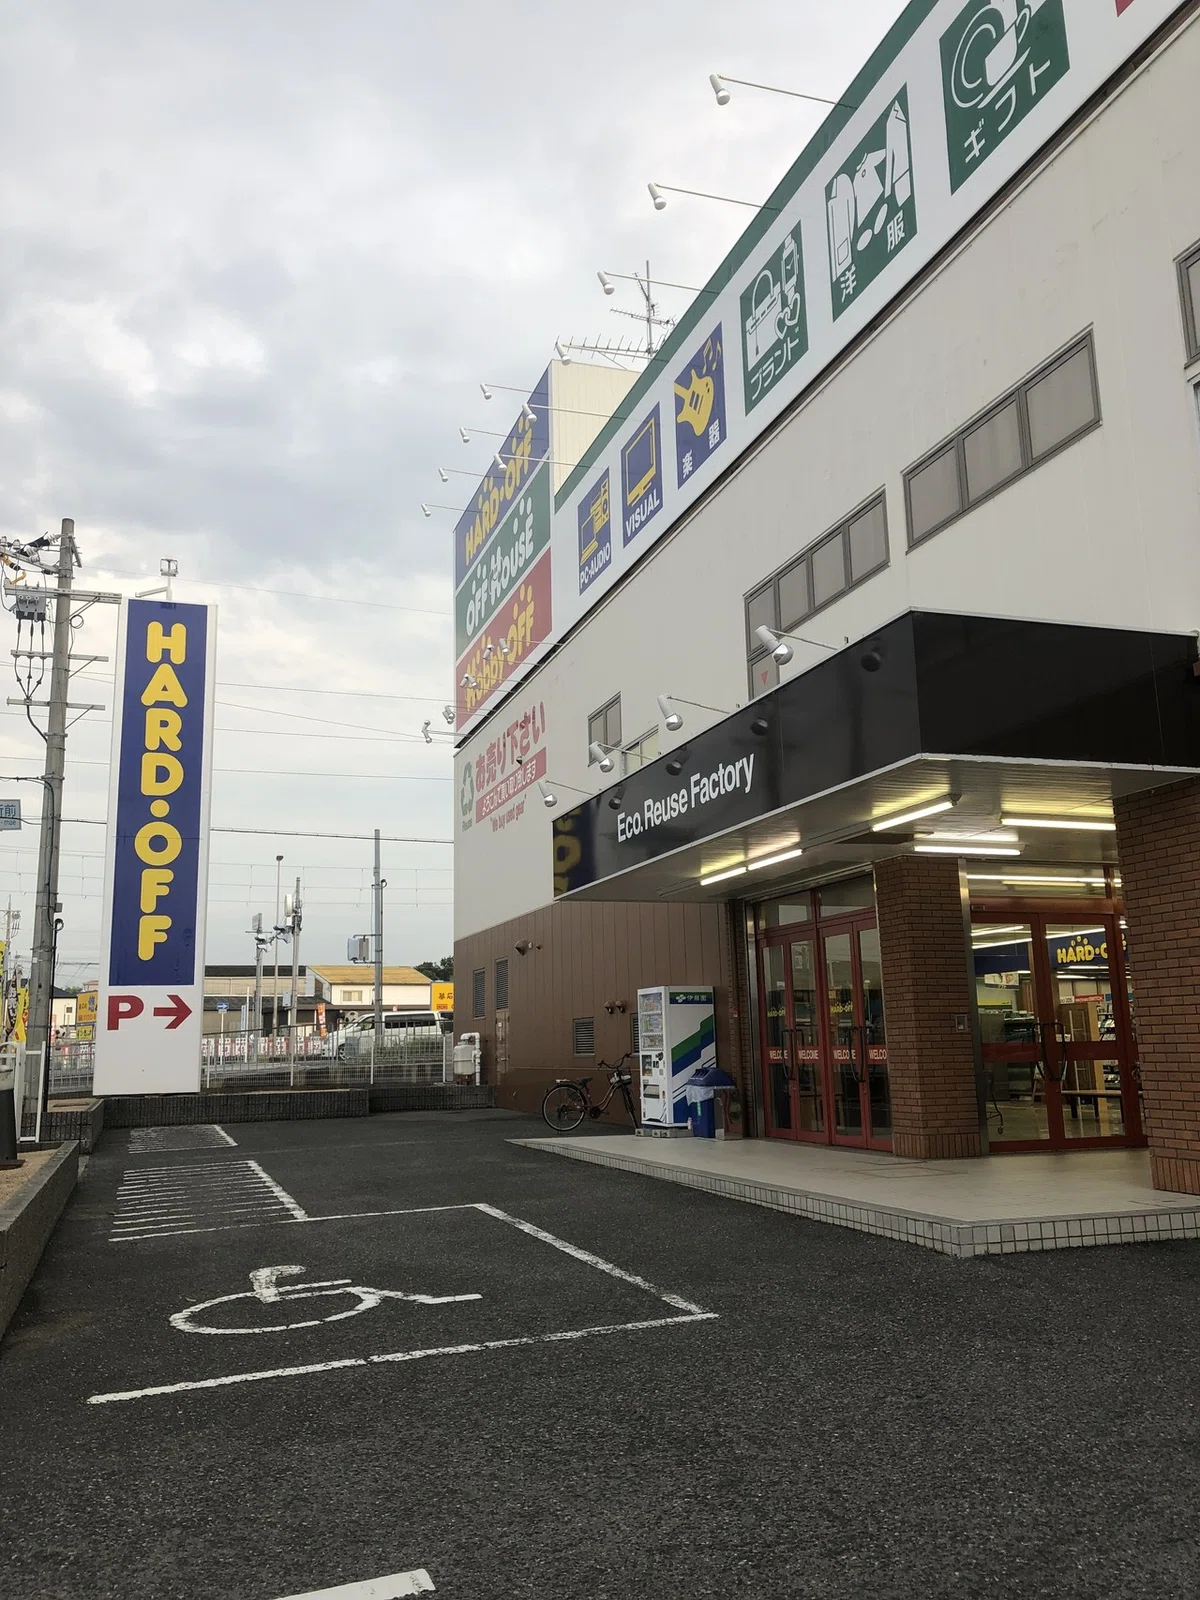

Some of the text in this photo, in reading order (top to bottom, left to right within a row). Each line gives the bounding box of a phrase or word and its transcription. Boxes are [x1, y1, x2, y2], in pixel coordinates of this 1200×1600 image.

[963, 59, 1051, 164] ギフト
[840, 209, 906, 304] 洋服
[750, 325, 800, 401] ブランド
[681, 418, 720, 479] 楽器
[625, 488, 661, 538] VISUAL
[465, 505, 534, 637] OFF HOUSE
[580, 541, 611, 589] PC-AUDIO
[506, 594, 535, 666] OFF
[475, 700, 546, 793] お売り下さい
[690, 753, 755, 809] Factory
[106, 993, 145, 1031] P
[798, 1050, 819, 1060] WELCOME
